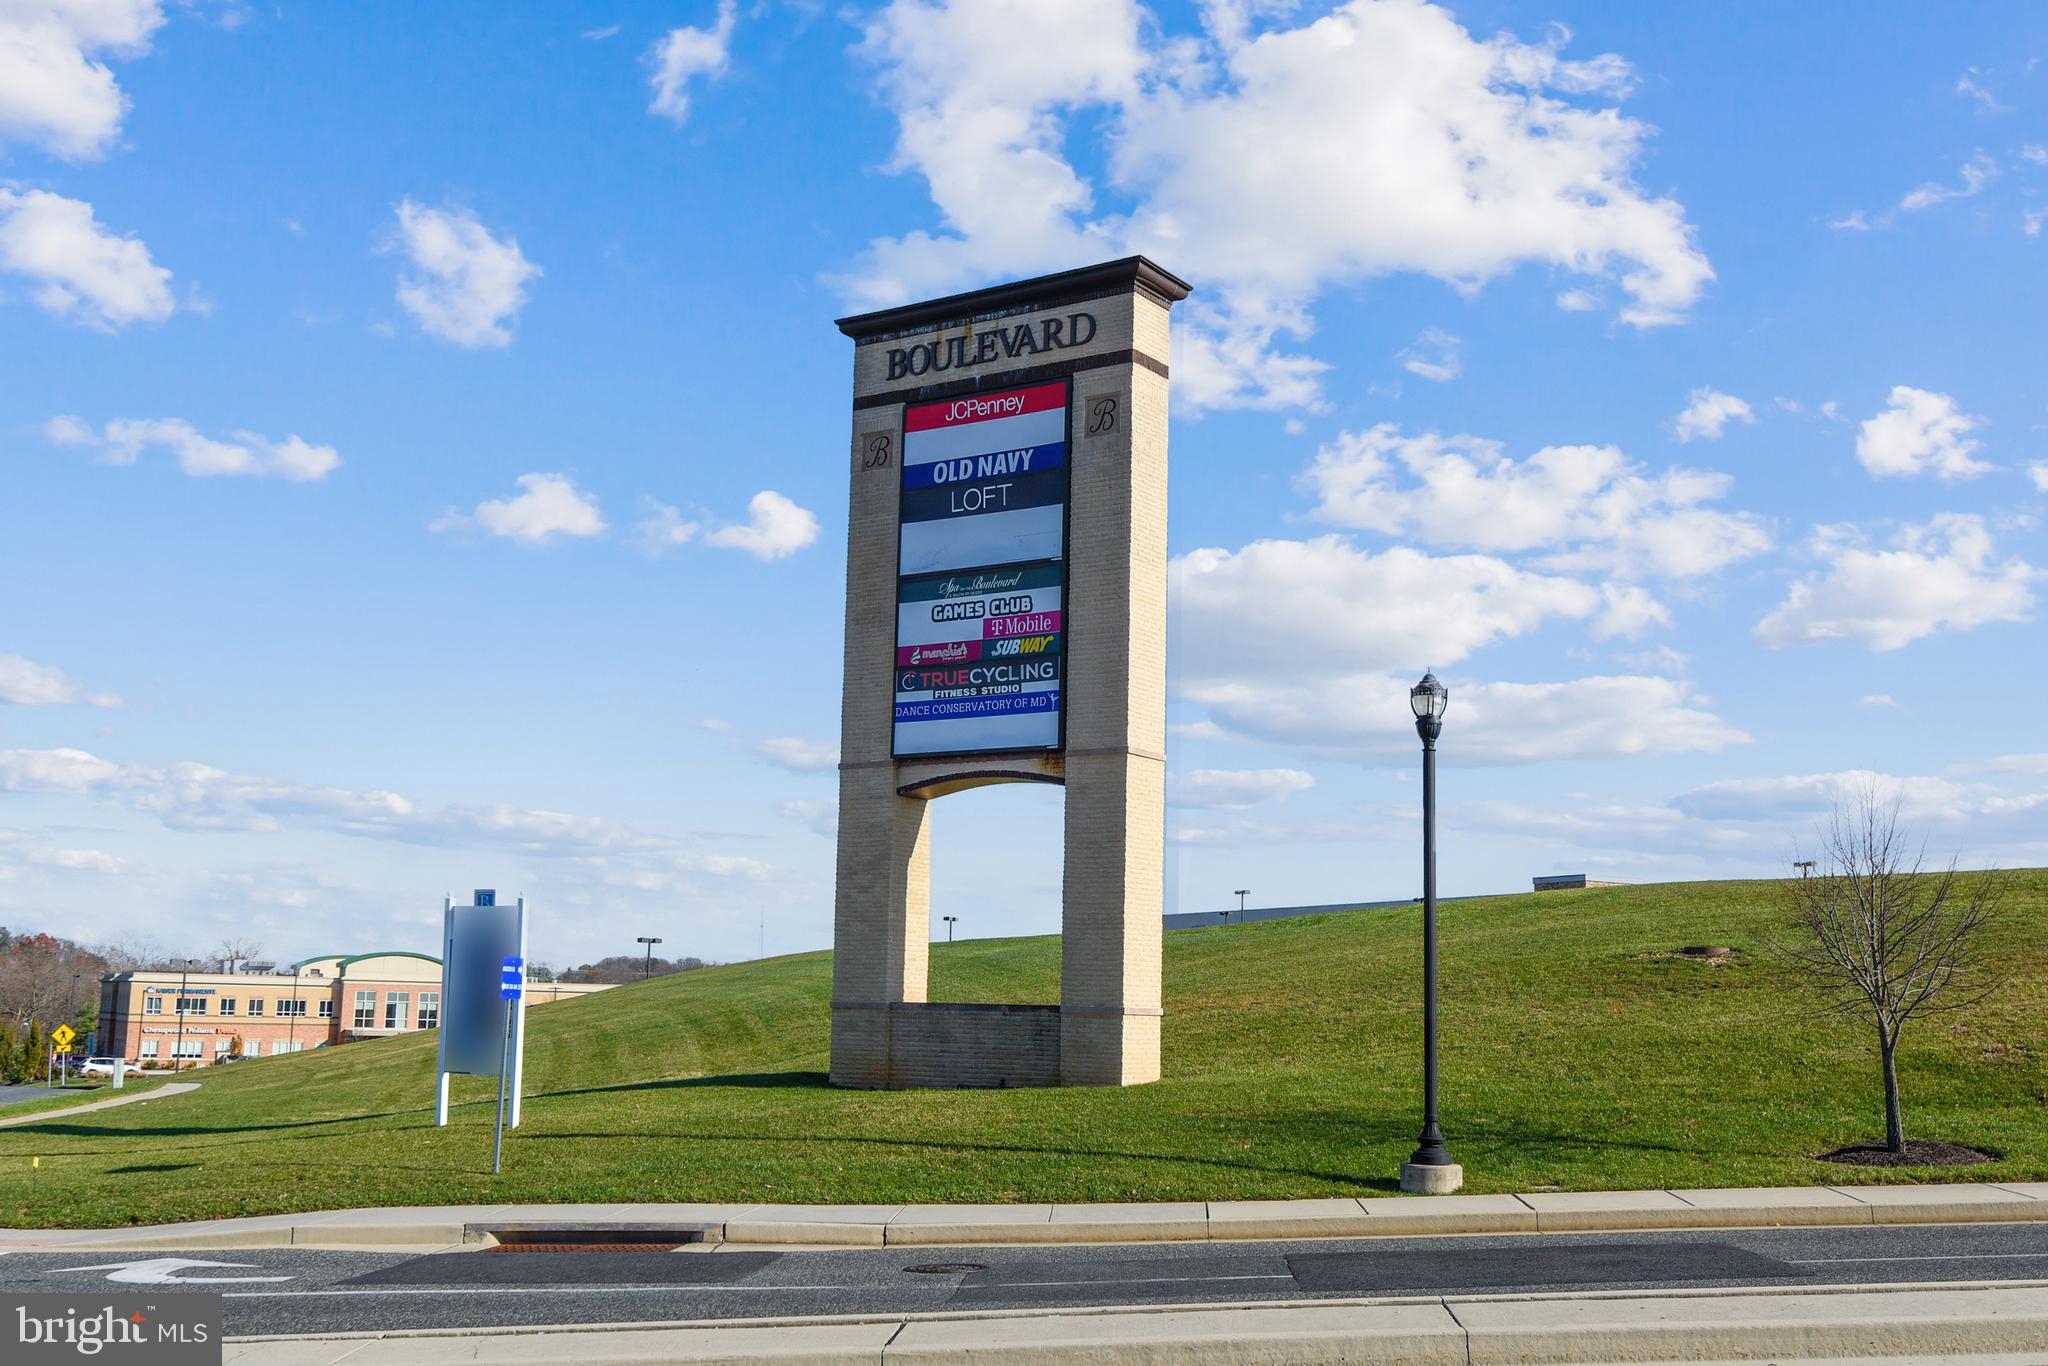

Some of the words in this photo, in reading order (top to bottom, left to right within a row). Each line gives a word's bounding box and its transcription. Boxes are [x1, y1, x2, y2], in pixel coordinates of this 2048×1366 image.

[886, 313, 1098, 381] BOULEVARD
[945, 395, 1025, 422] JCPenney
[933, 458, 973, 484] OLD
[977, 449, 1034, 476] NAVY
[951, 484, 1013, 513] LOFT
[973, 572, 1022, 590] Boulevard
[932, 601, 985, 623] GAMES
[989, 595, 1033, 615] CLUB
[991, 635, 1054, 656] SUBWAY
[920, 662, 1054, 688] TRUECYCLING
[935, 688, 977, 699] FITNESS
[981, 684, 1020, 695] STUDIO
[896, 705, 930, 717] DANCE
[932, 699, 1012, 715] CONSERVATORY
[1014, 699, 1028, 709] OF
[1030, 696, 1046, 707] MD
